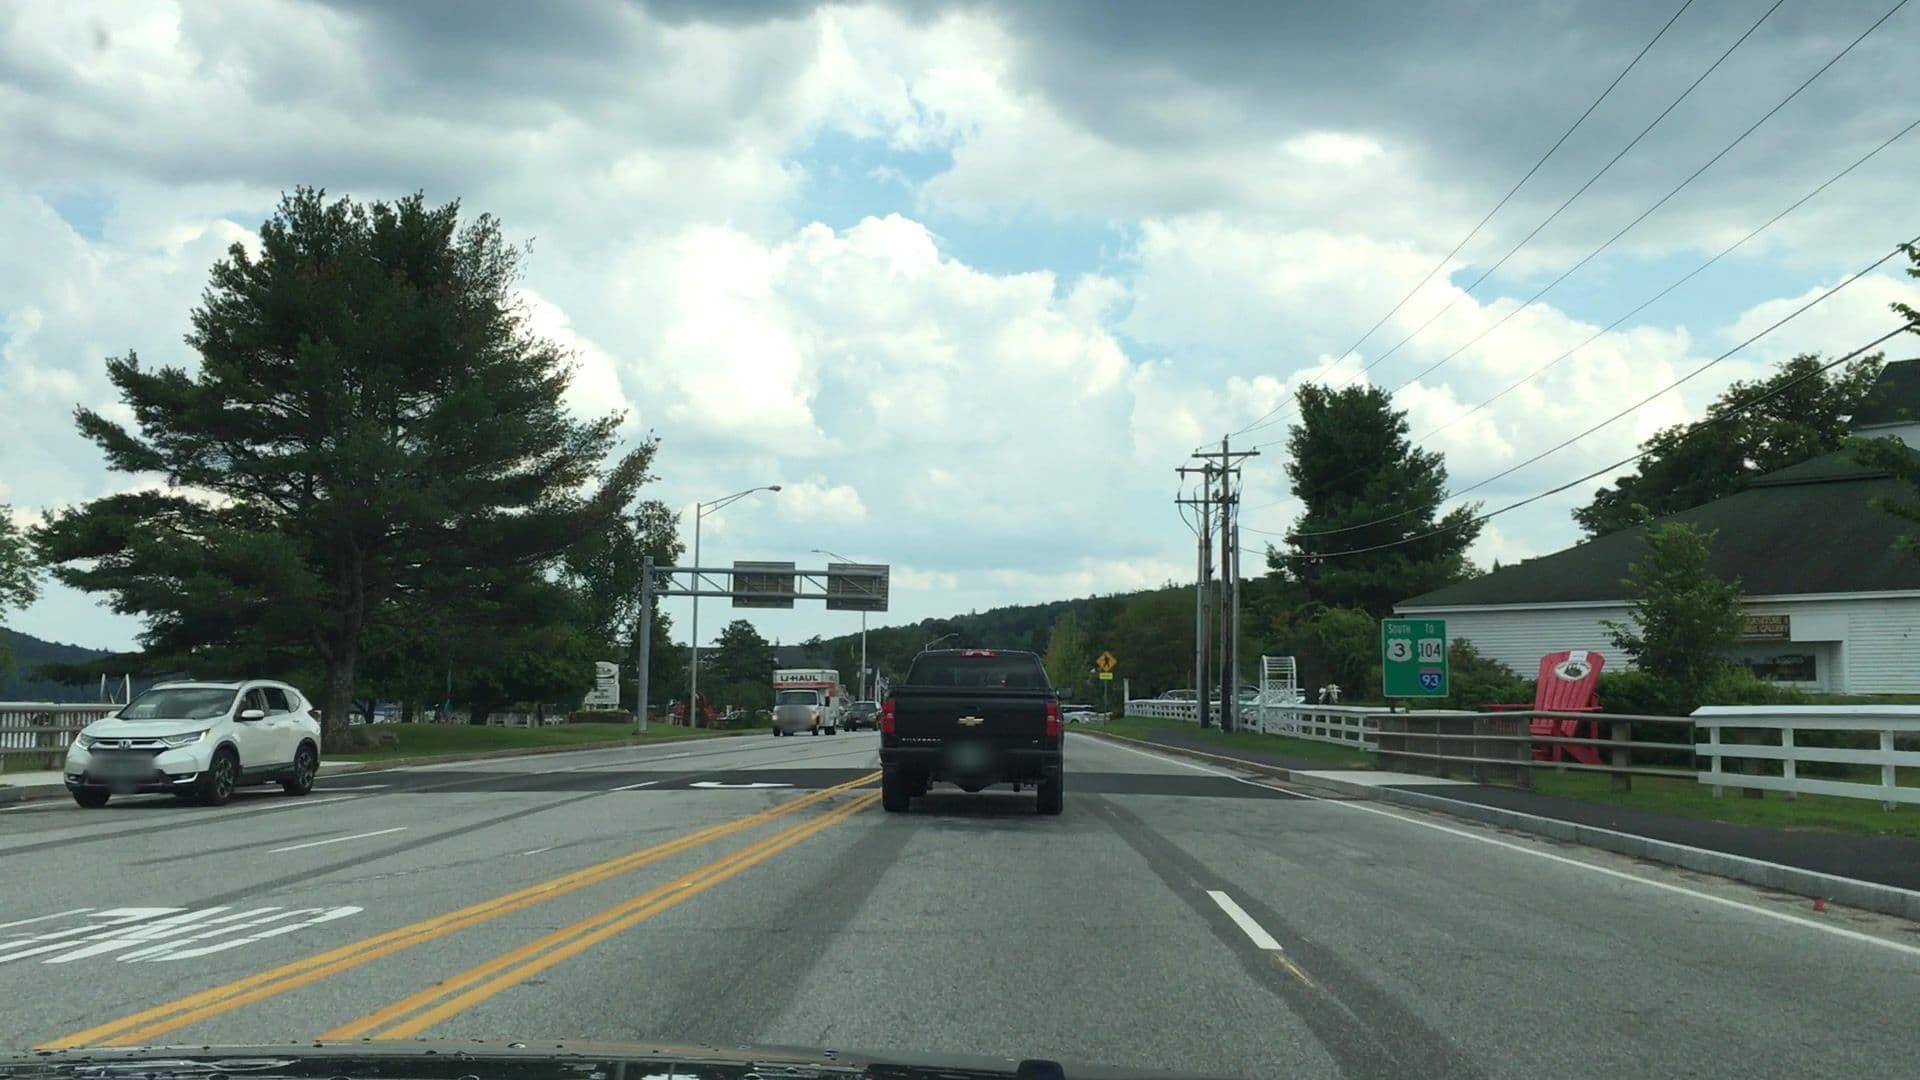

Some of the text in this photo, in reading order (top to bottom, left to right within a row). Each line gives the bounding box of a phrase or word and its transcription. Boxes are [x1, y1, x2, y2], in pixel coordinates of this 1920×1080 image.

[1393, 642, 1406, 658] 3
[1420, 642, 1441, 658] 104
[780, 674, 819, 682] U-HAUL
[1421, 674, 1440, 687] 93
